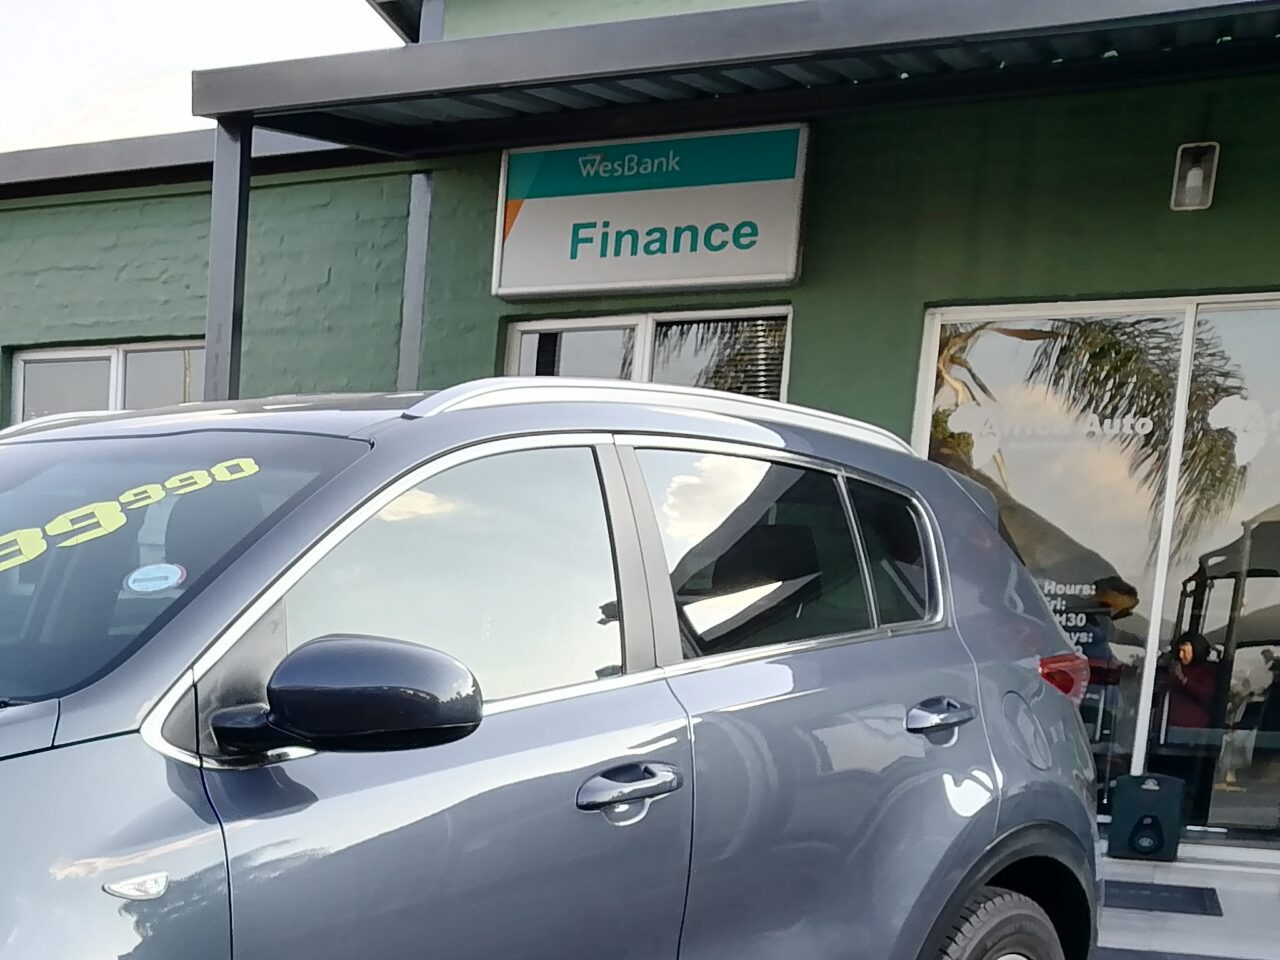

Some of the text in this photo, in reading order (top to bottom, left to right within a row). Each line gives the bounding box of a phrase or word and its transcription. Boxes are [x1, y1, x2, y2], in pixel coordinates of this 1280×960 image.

[579, 150, 680, 178] WesBank
[570, 219, 759, 260] Finance
[1086, 413, 1154, 435] Auto
[1044, 581, 1096, 596] Hours:
